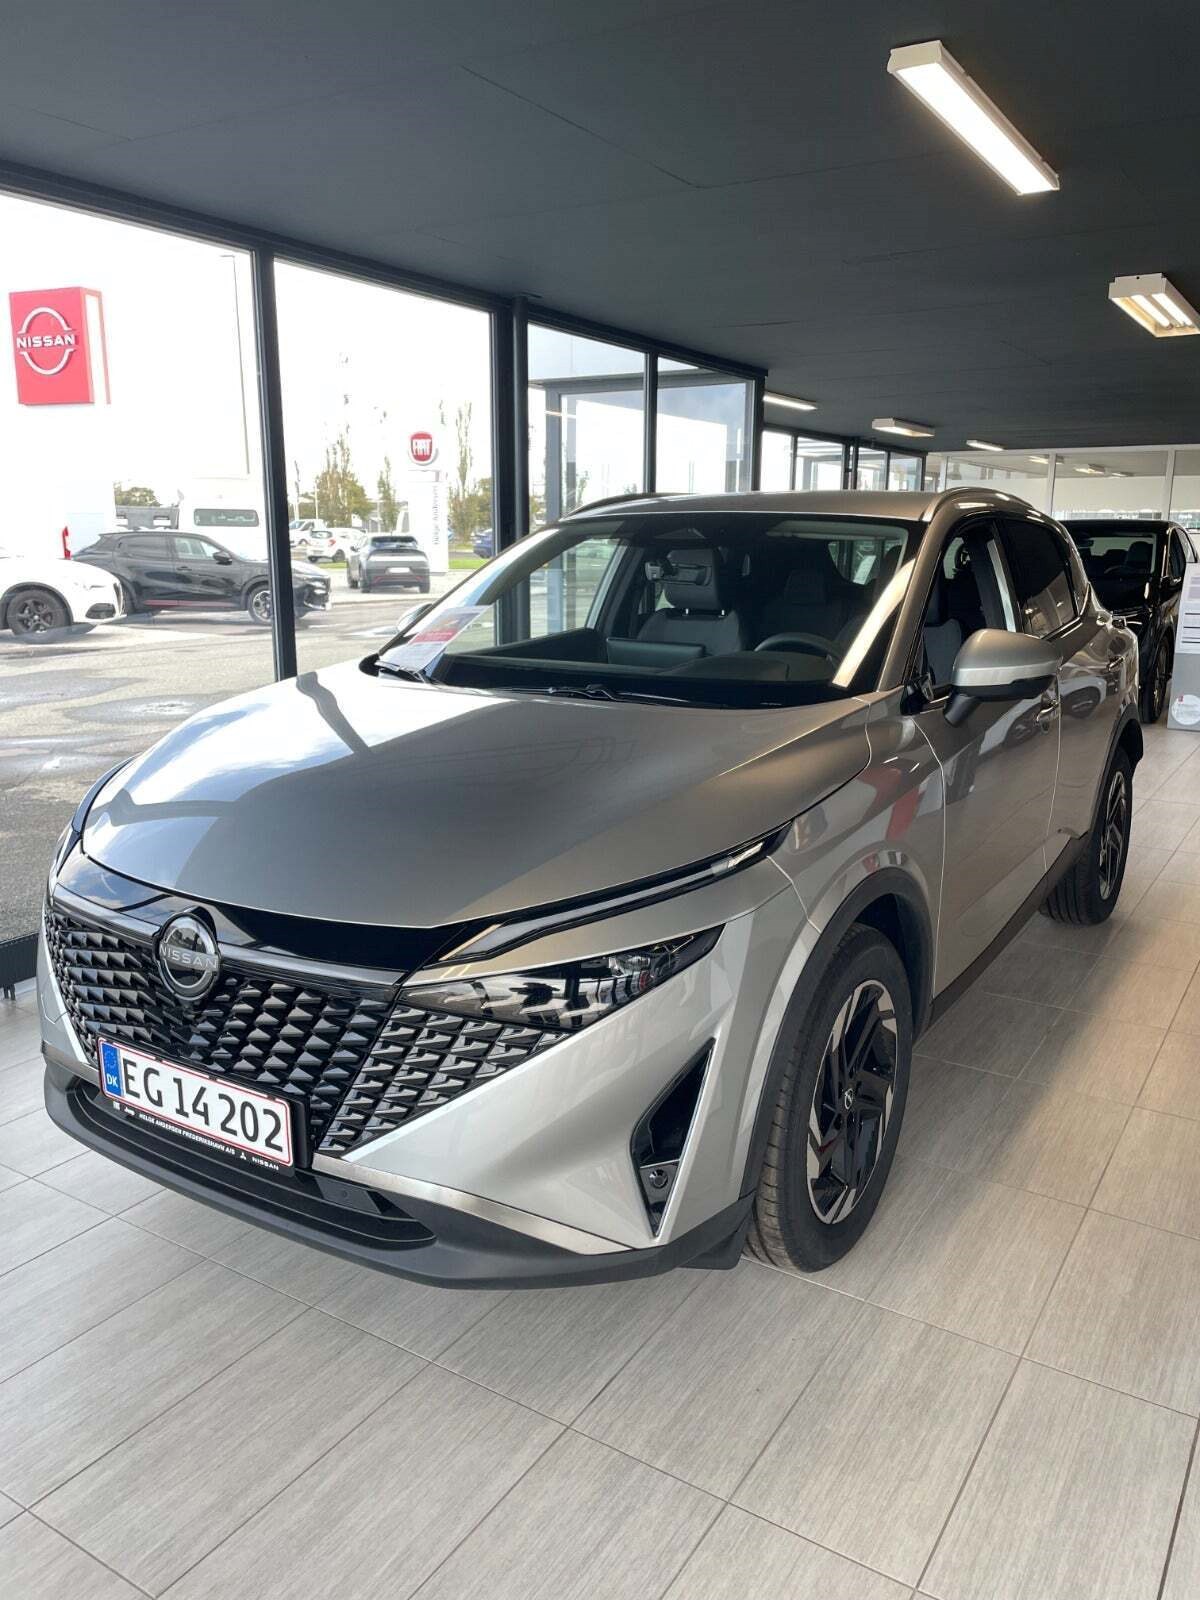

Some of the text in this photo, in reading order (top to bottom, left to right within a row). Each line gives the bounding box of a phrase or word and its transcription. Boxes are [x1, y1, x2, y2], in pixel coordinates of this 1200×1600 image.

[16, 335, 75, 348] NISSAN
[160, 943, 218, 969] NISSAN
[106, 1073, 119, 1088] DK
[252, 1156, 279, 1171] NISSAN
